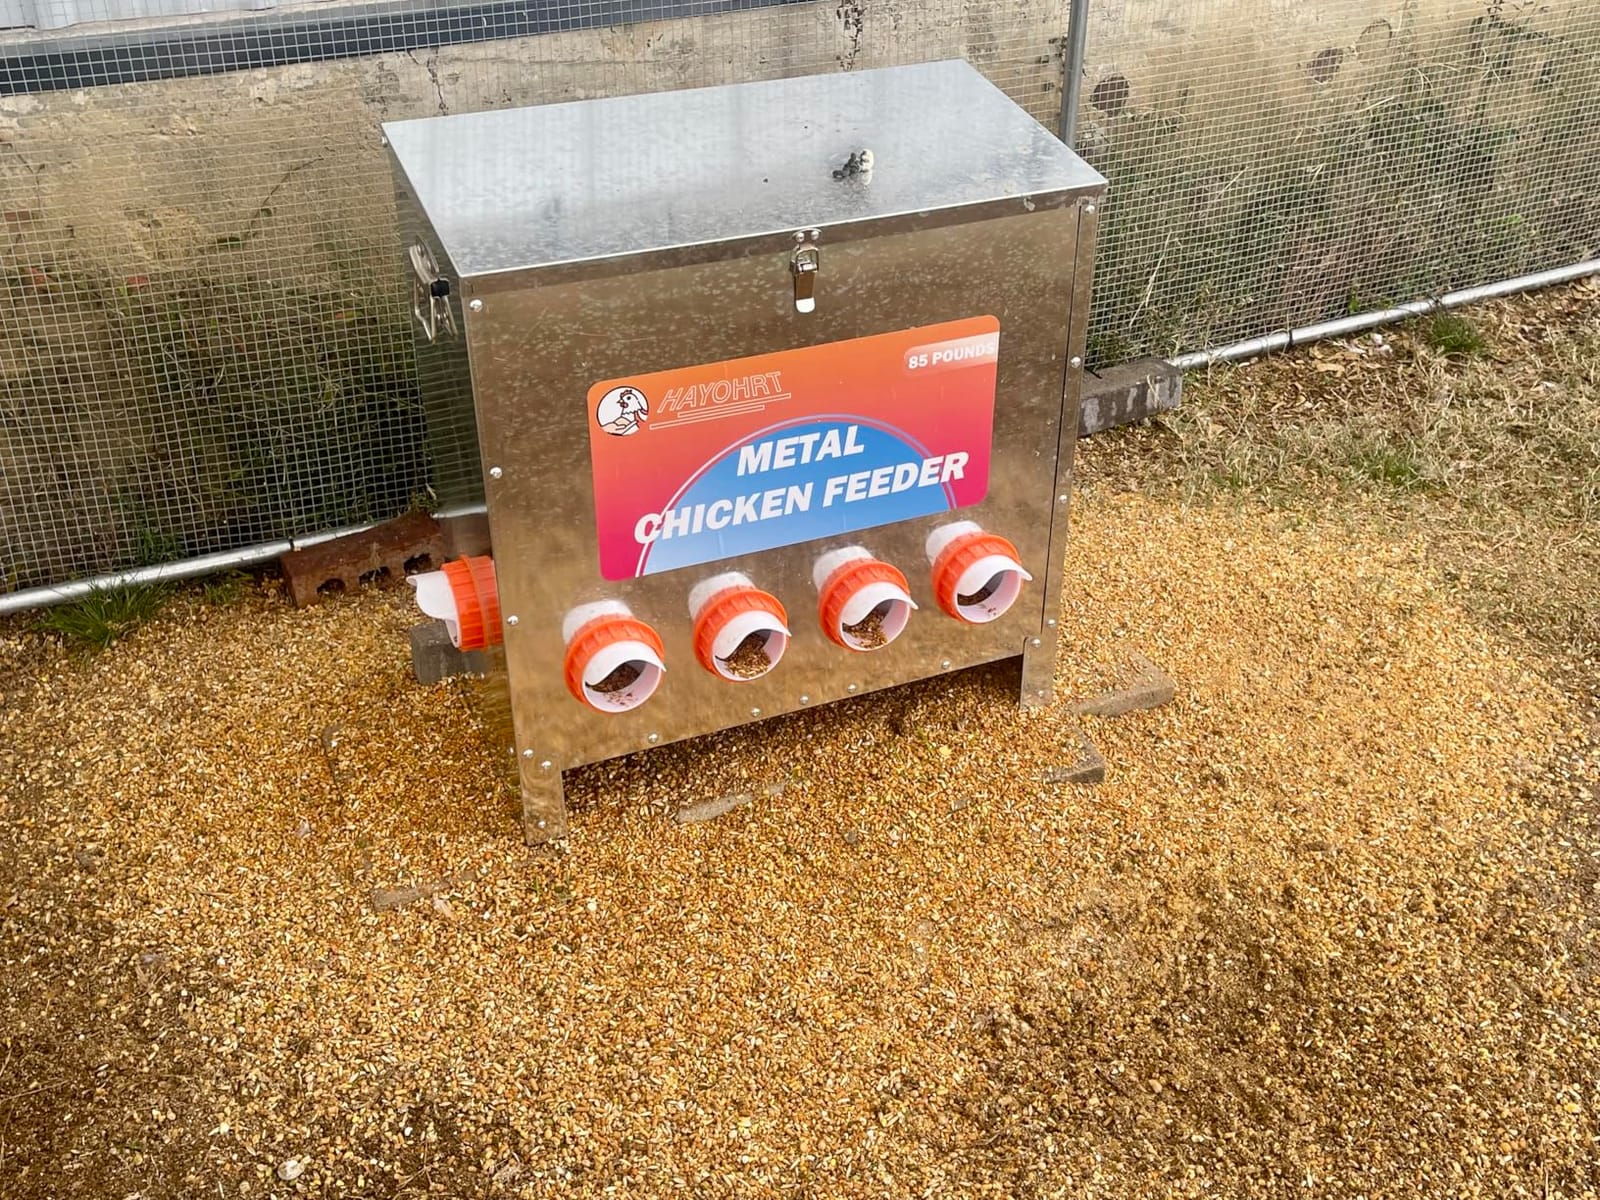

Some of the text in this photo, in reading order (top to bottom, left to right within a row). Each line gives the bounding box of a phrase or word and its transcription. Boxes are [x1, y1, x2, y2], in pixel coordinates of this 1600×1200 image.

[908, 341, 996, 370] 85 POUNDS
[657, 371, 782, 413] HAYOHRT
[736, 425, 865, 477] METAL
[634, 451, 969, 545] CHICKEN FEEDER
